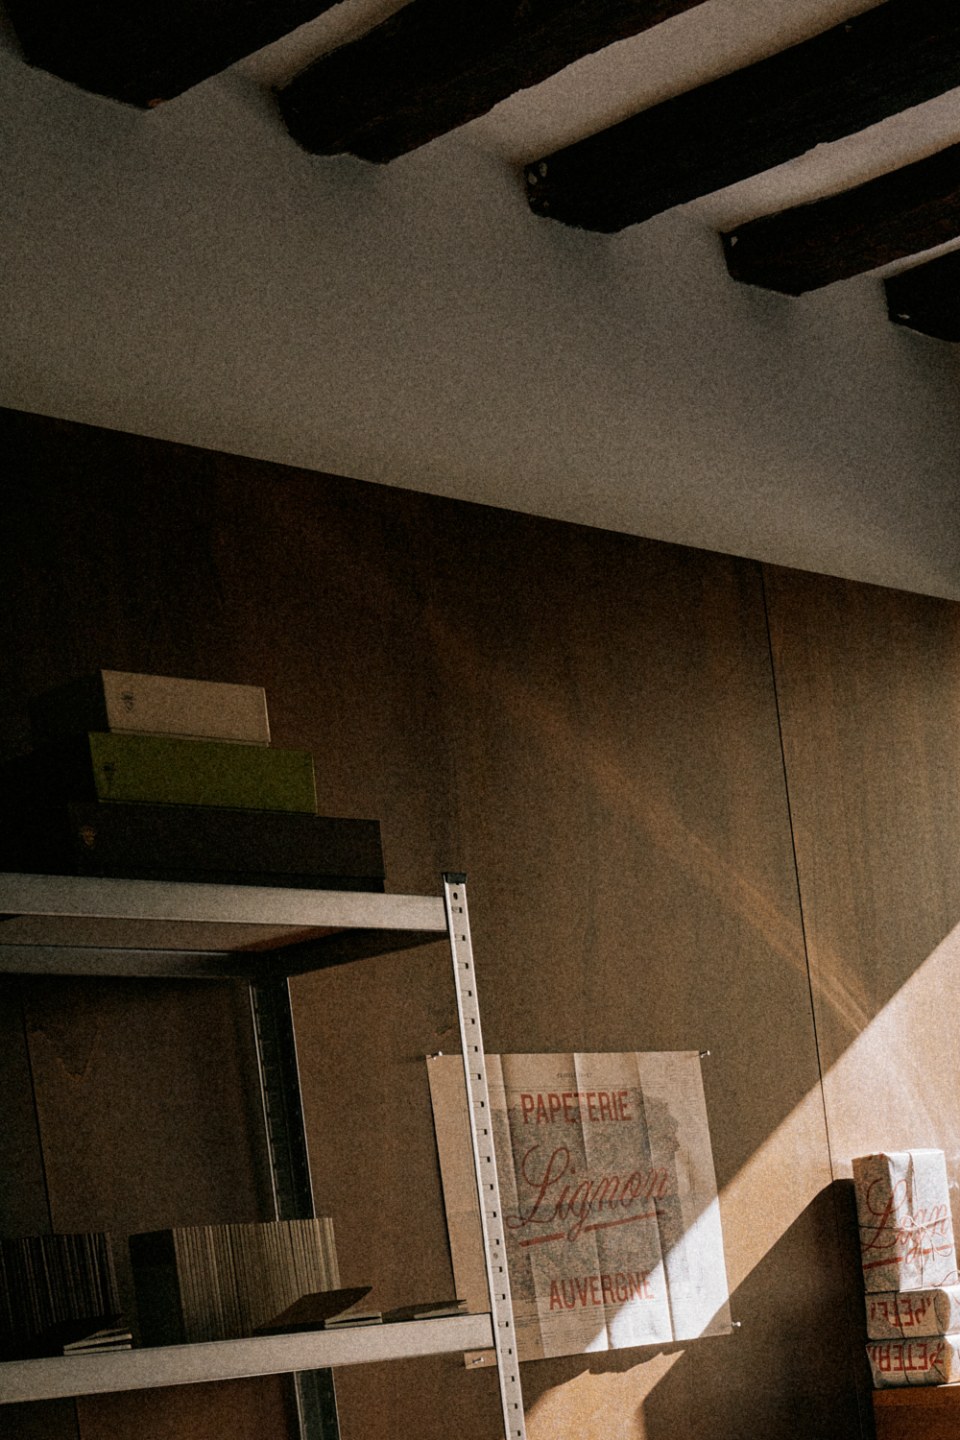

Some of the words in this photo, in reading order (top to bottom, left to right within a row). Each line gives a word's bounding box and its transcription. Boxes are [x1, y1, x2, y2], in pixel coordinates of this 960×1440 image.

[520, 1091, 632, 1124] PAPETERIE
[505, 1145, 668, 1242] Lignon
[550, 1271, 655, 1311] AUVERGNE
